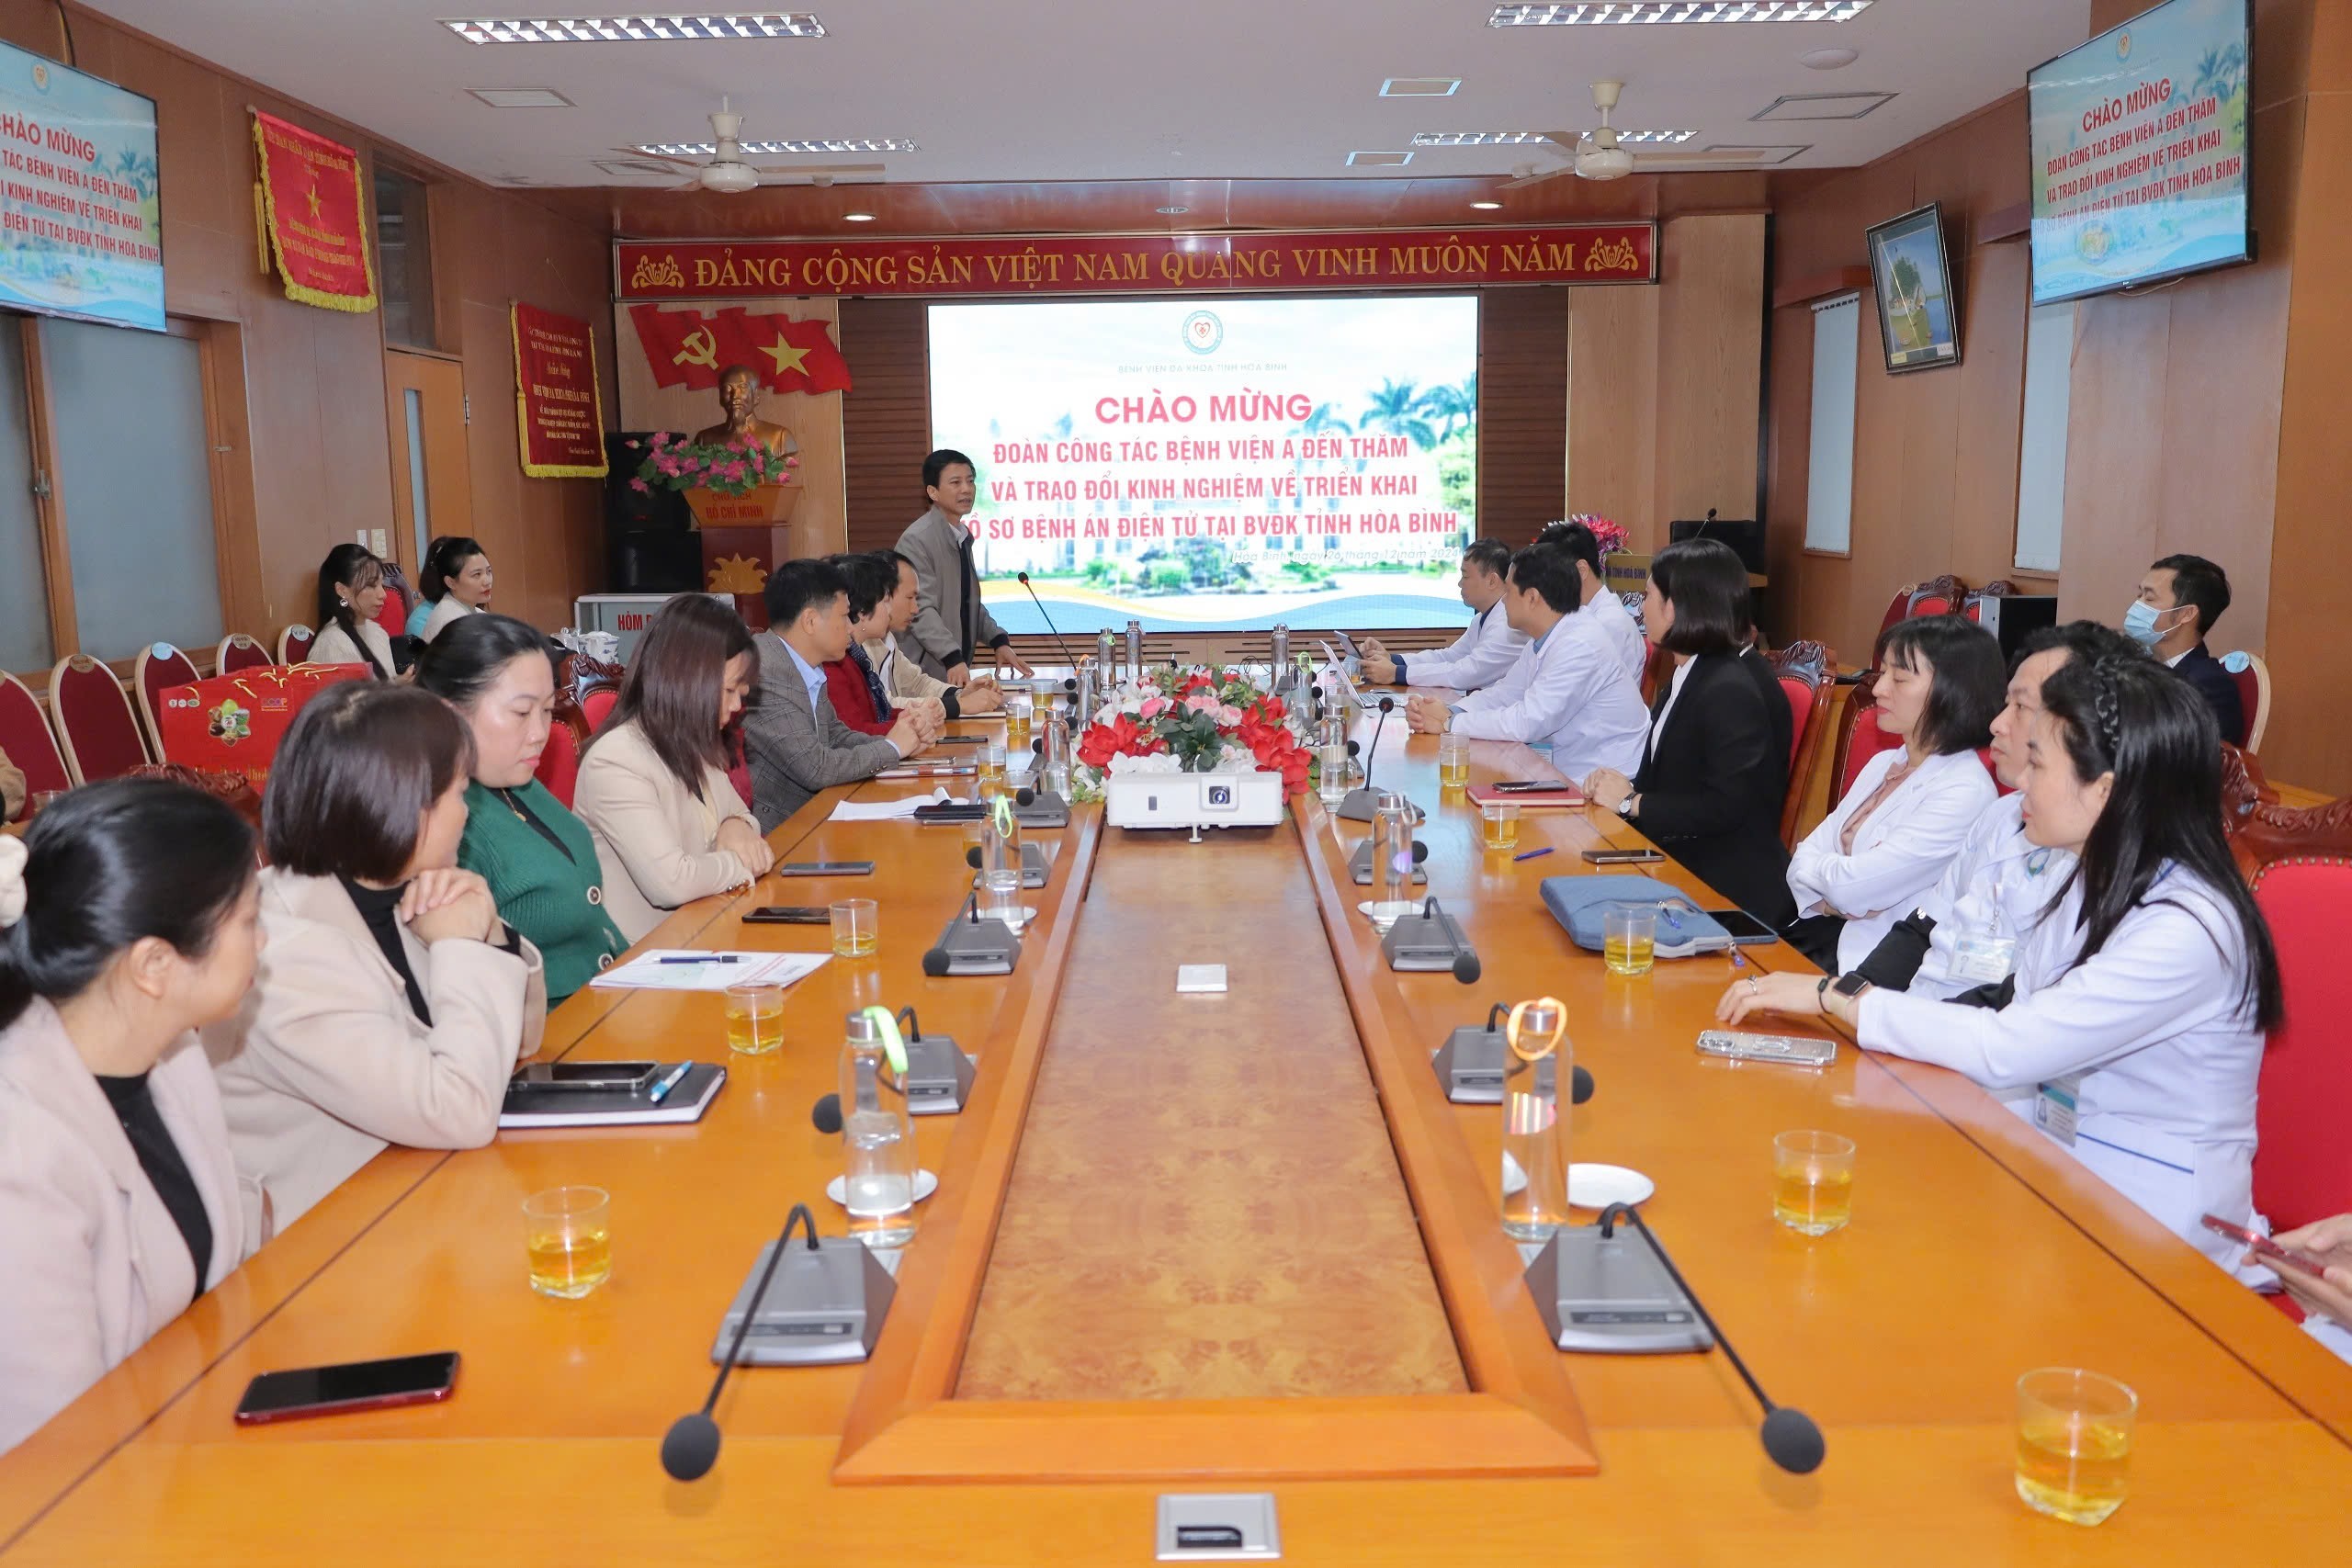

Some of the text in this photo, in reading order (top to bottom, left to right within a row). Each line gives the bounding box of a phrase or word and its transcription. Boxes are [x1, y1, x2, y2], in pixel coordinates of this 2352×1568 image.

[2083, 77, 2171, 132] CHÀO MỪNG
[0, 111, 95, 162] HÀO MỪNG
[695, 234, 1576, 293] ĐẢNG CỘNG SẢN VIỆT NAM QUANG VINH MUÔN NĂM
[1094, 387, 1313, 423] CHÀO MỪNG
[993, 431, 1408, 465] ĐOÀN CÔNG TÁC BỆNH VIỆN A ĐẾN THĂM
[991, 466, 1418, 502] VÀ TRAO ĐỔI KINH NGHIỆM VỀ TRIỂN KHAI
[960, 508, 1456, 543] Ồ SƠ BỆNH ÁN ĐIỆN TỬ TẠI BVĐK TỈNH HÒA BÌNH
[617, 610, 643, 631] HÒM
